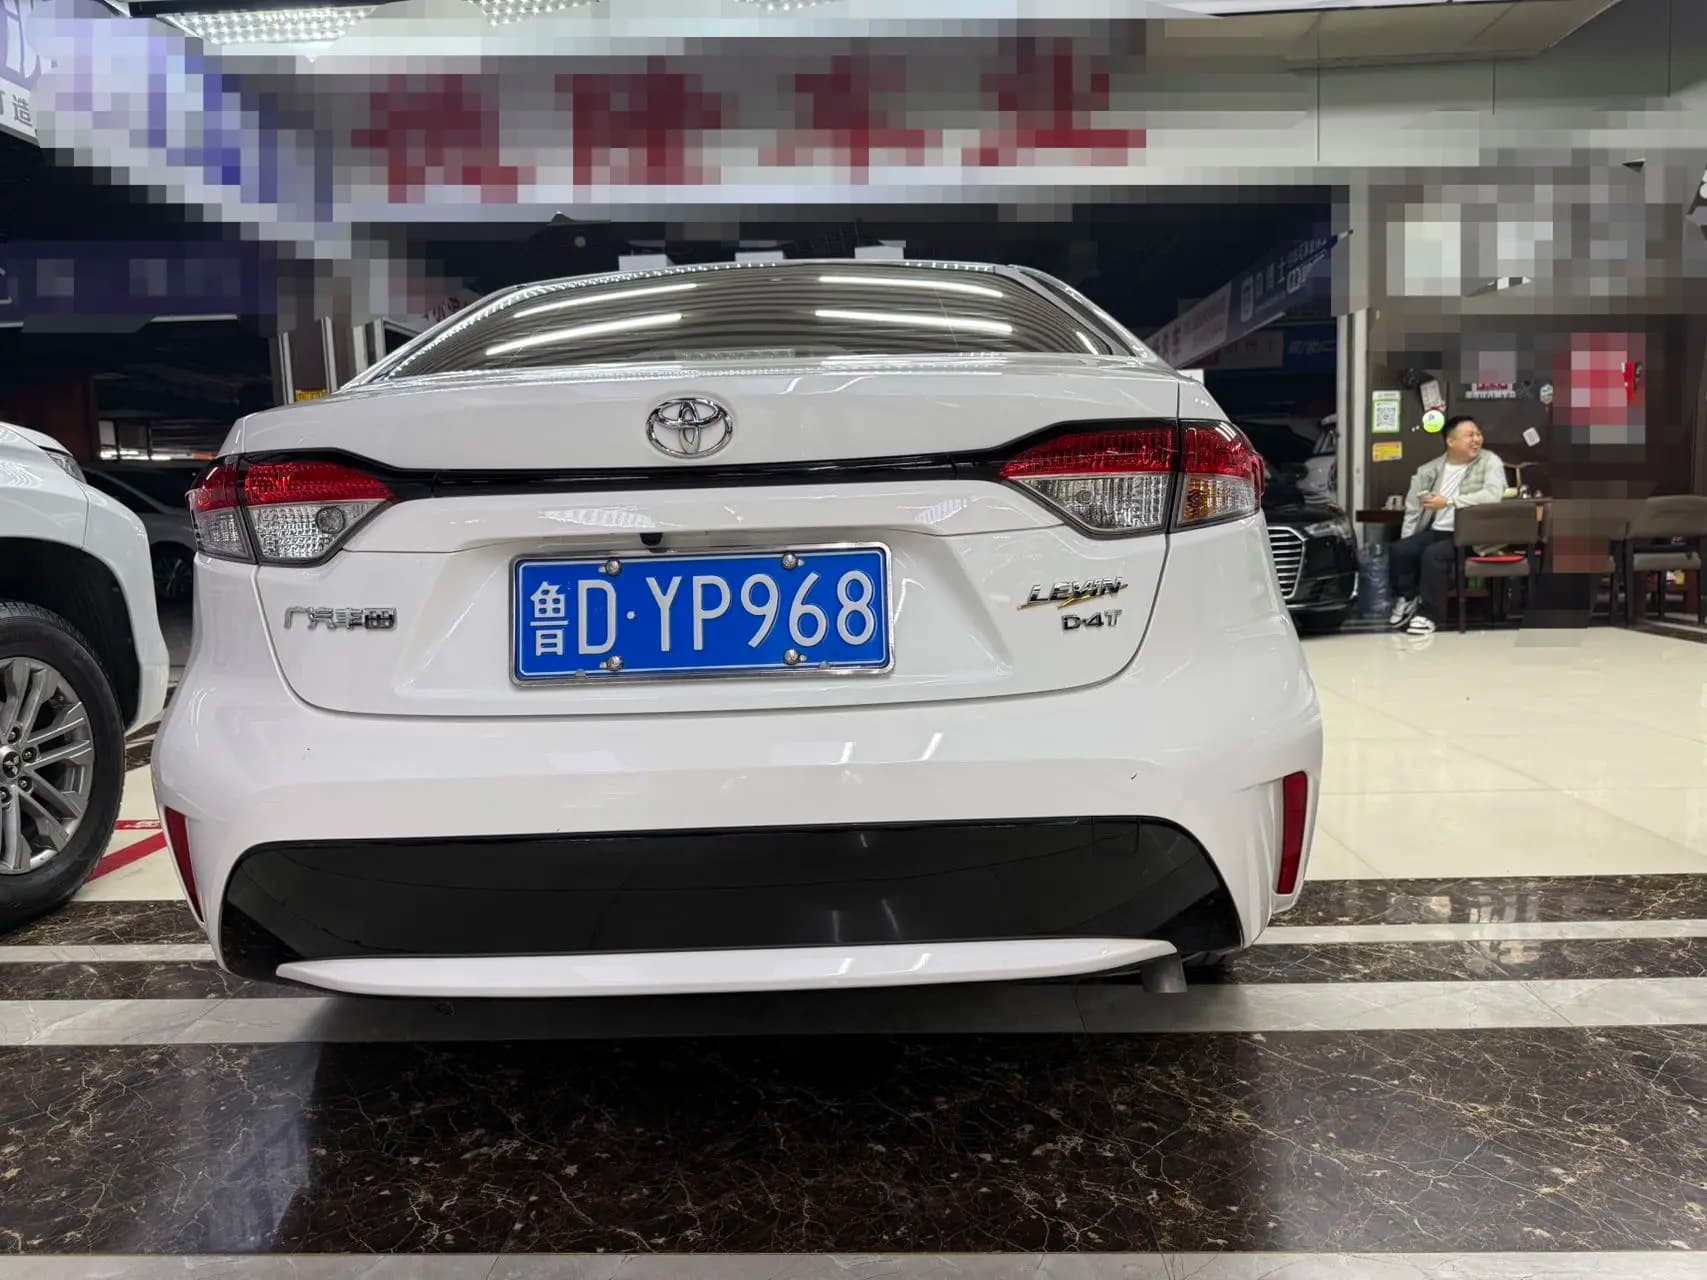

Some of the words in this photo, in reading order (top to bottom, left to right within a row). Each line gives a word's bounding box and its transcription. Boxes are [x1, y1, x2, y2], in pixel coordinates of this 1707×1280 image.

[1026, 576, 1124, 604] LEVIN
[284, 606, 397, 630] 广汽丰田
